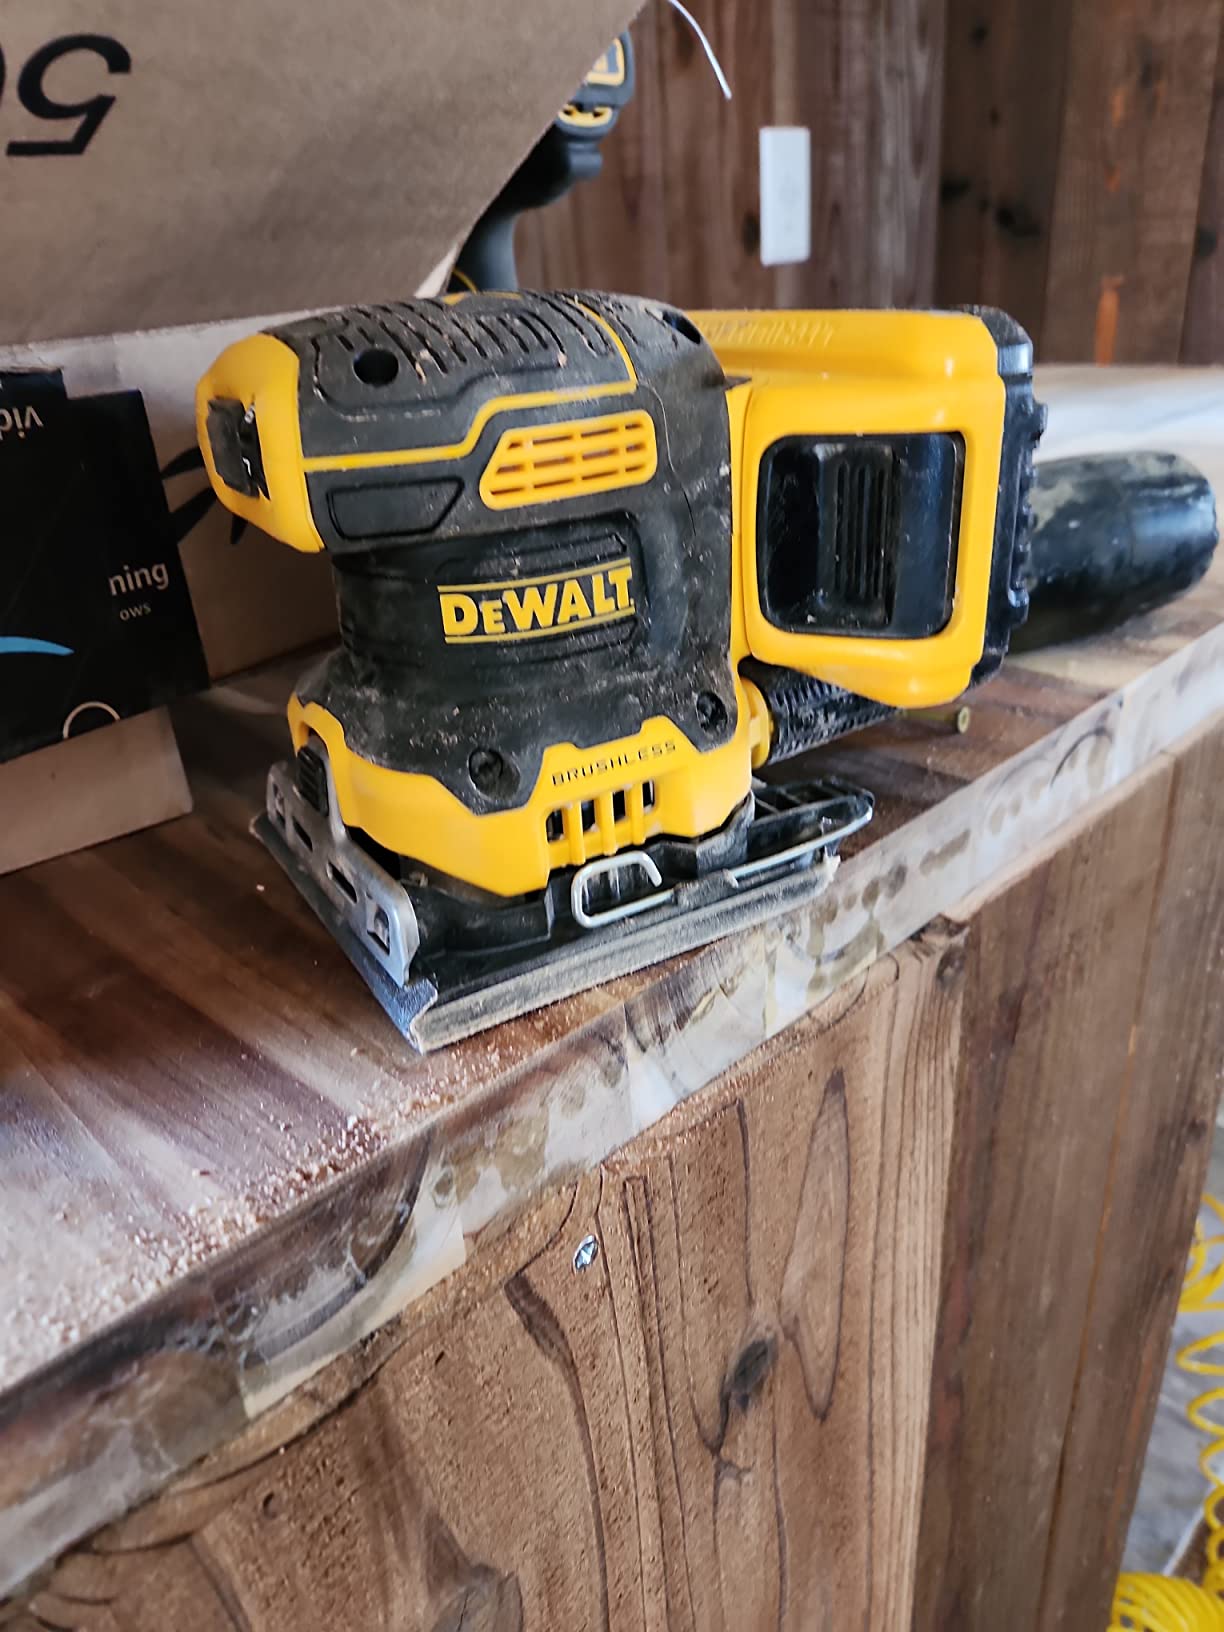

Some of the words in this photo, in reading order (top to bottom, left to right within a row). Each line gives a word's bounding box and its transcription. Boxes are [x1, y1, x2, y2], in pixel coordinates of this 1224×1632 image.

[108, 562, 169, 596] ning
[439, 566, 633, 636] DEWALT
[552, 742, 676, 786] BRUSHLESS
